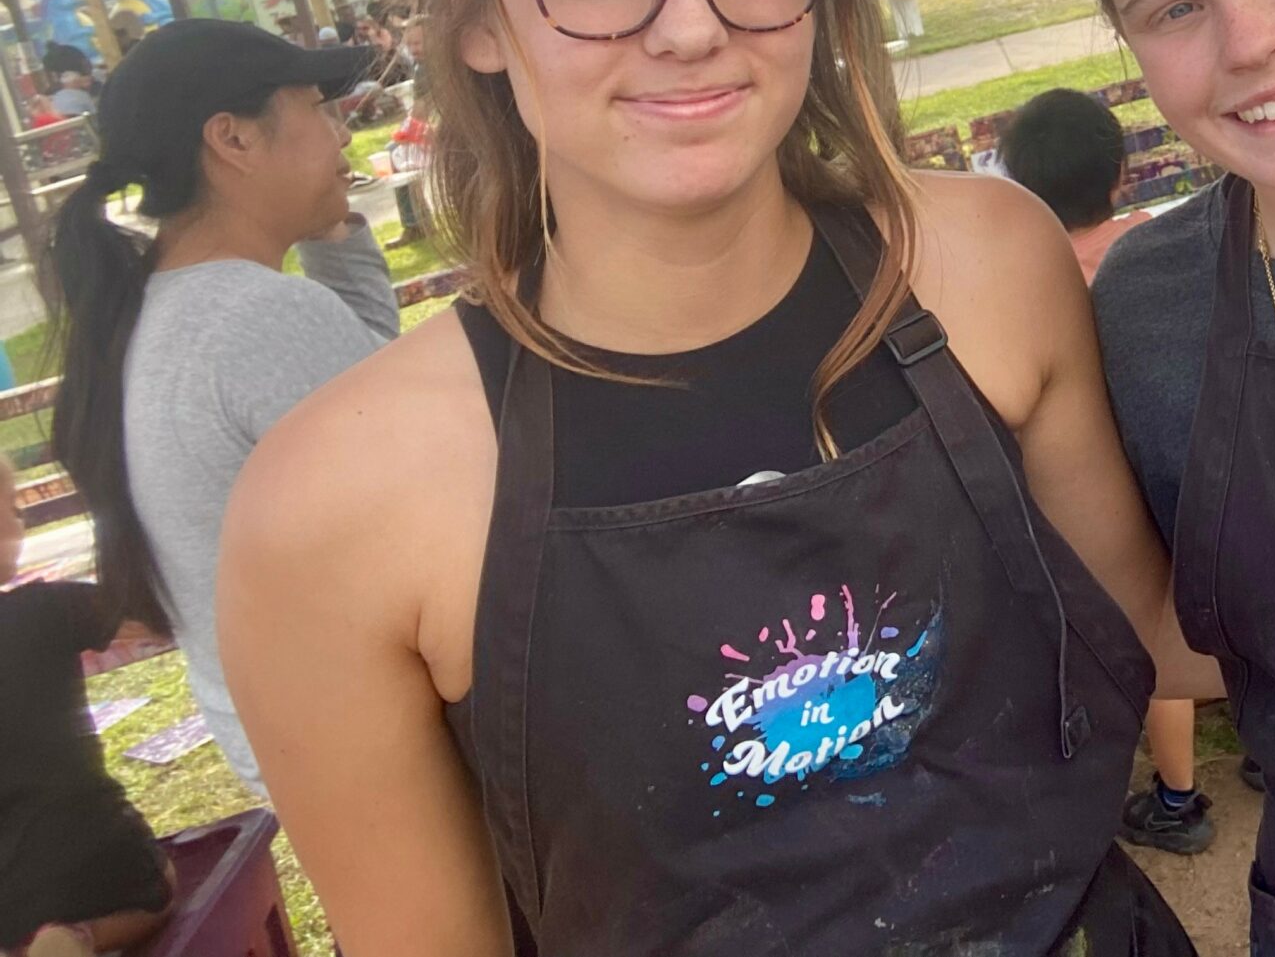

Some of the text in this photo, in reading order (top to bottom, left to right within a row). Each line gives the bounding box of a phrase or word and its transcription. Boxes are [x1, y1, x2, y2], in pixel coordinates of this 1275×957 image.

[705, 647, 901, 732] Emotion
[800, 700, 835, 727] in
[723, 696, 905, 777] Motion
